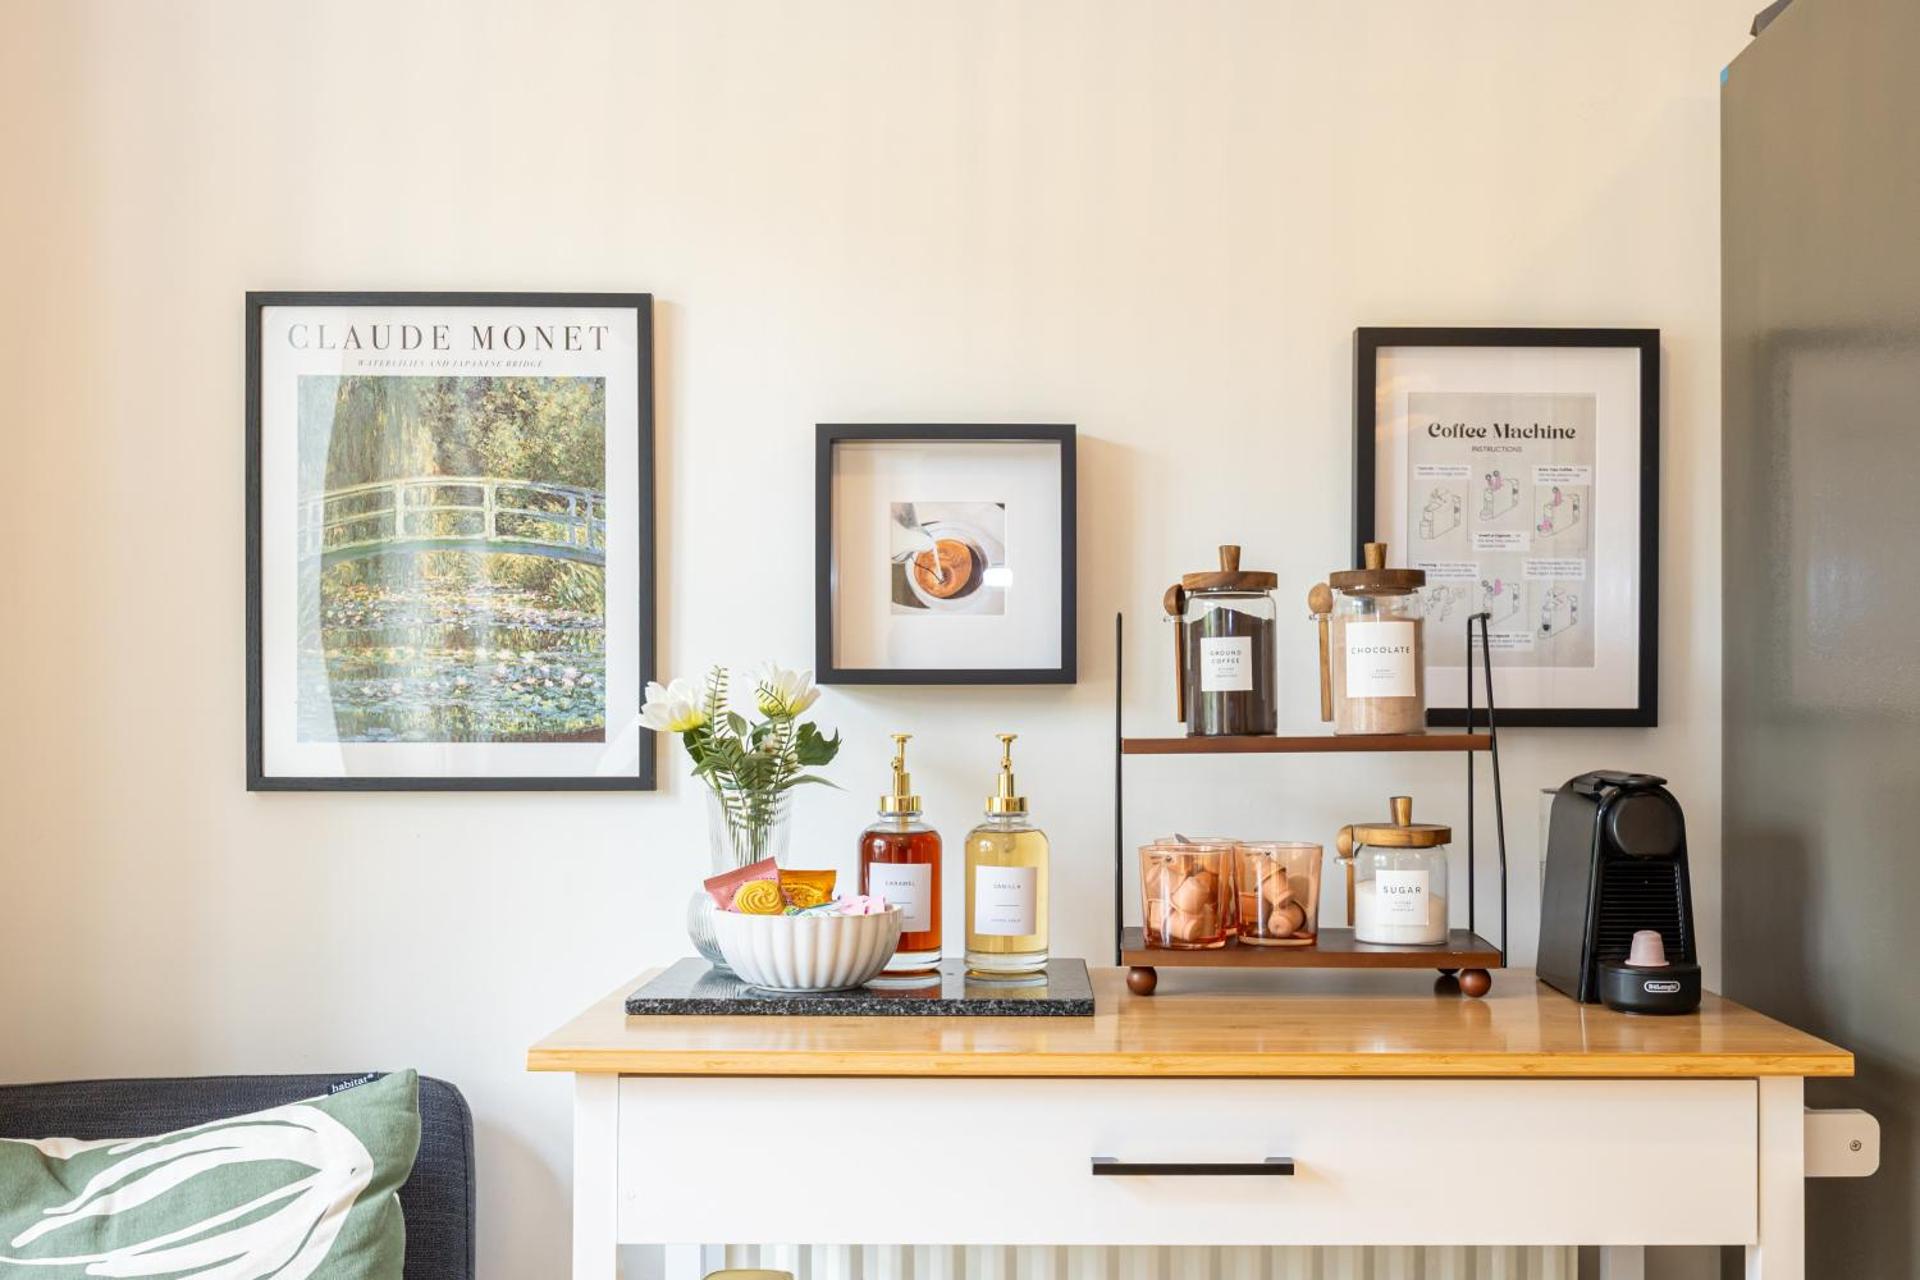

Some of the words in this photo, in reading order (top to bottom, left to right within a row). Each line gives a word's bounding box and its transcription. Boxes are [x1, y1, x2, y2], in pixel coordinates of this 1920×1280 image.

[287, 324, 450, 350] CLAUDE
[471, 324, 610, 350] MONET
[1428, 422, 1487, 438] Coffee
[1493, 422, 1576, 439] Machine
[1351, 646, 1410, 655] CHOCOLATE
[1383, 885, 1421, 894] SUGAR
